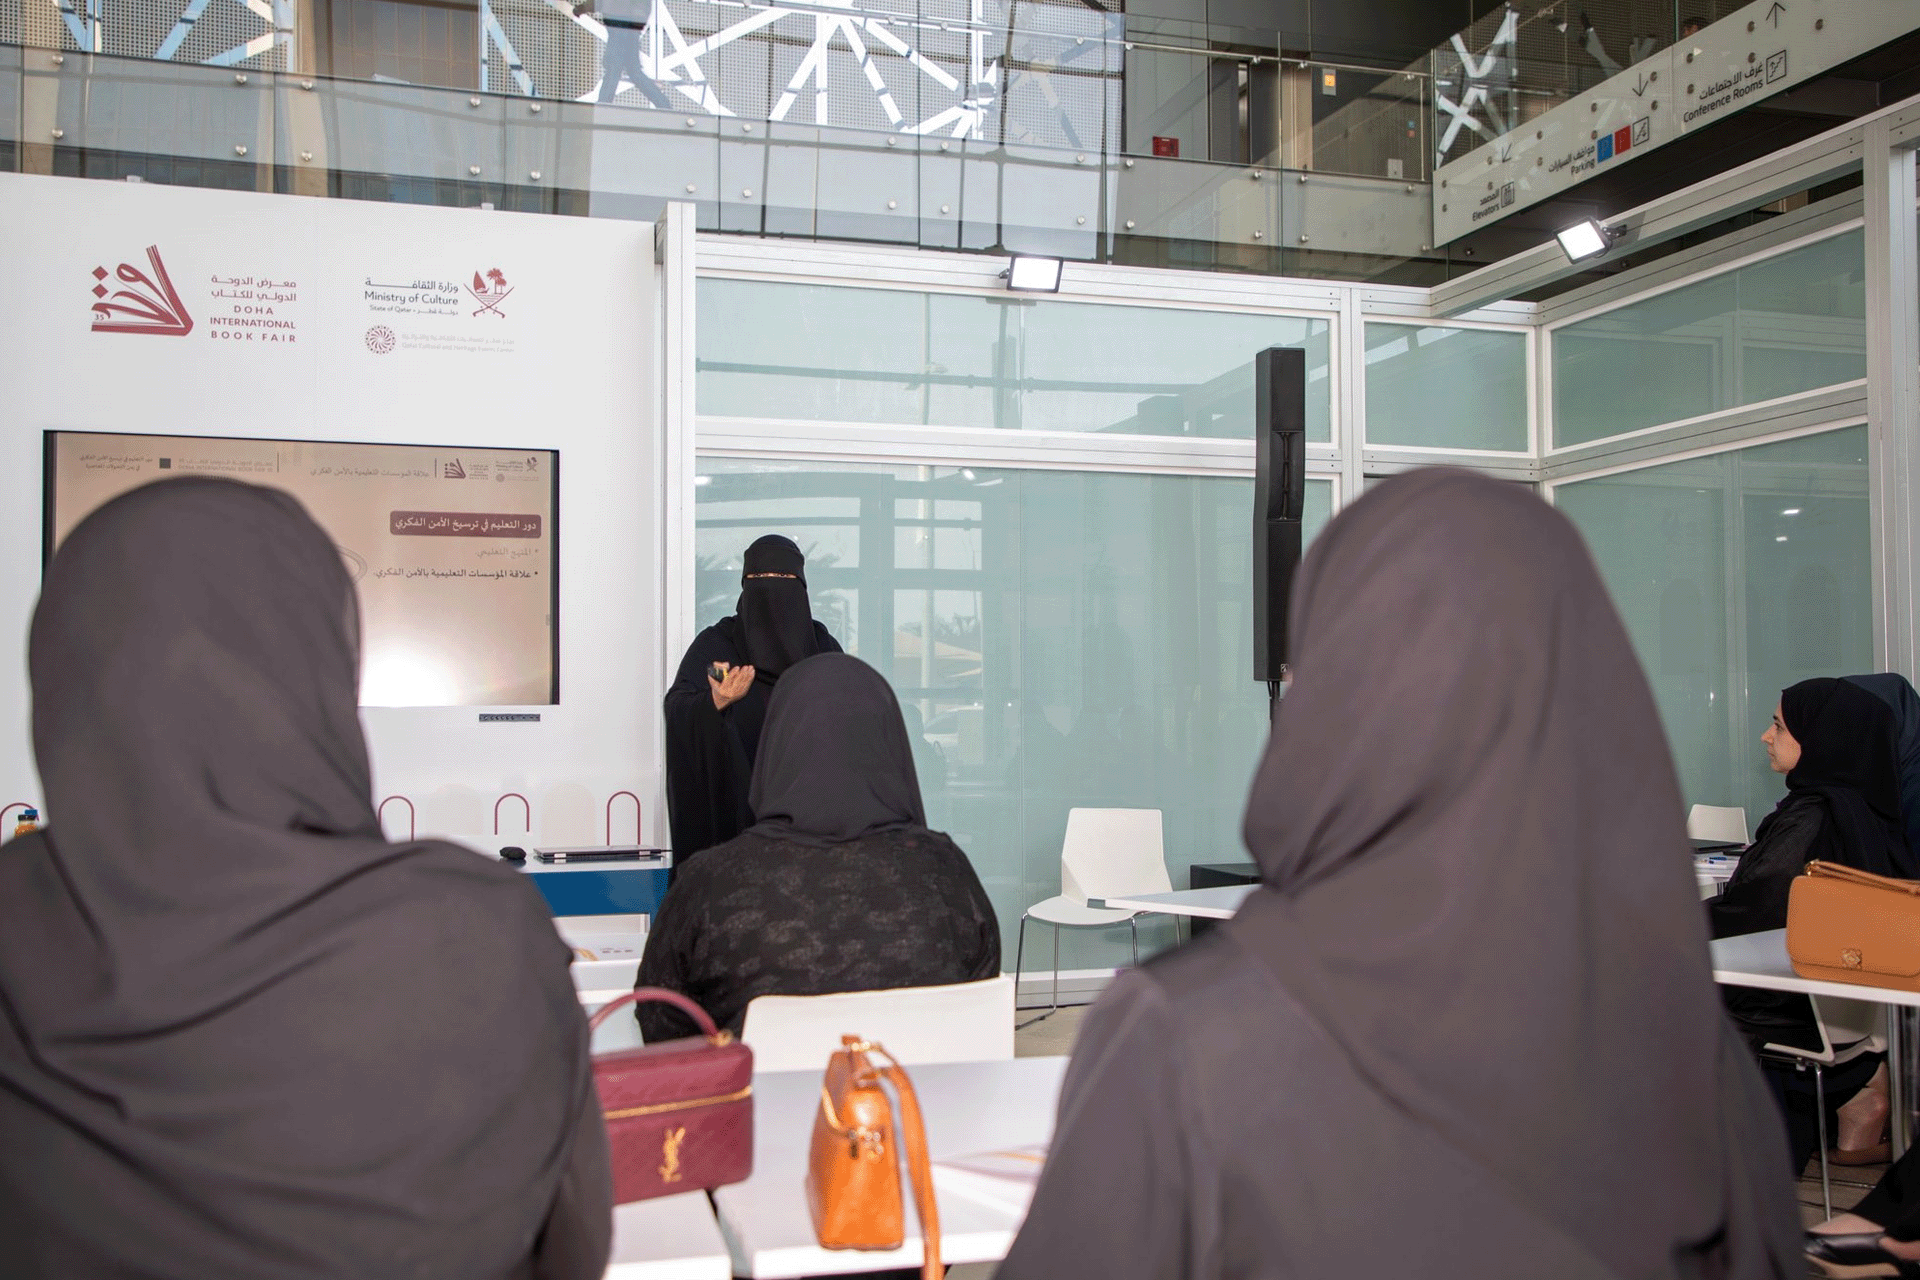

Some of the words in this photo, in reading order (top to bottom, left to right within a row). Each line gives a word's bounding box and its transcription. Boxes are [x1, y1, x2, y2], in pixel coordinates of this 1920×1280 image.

[1744, 62, 1763, 78] غرف
[1699, 72, 1742, 100] الاجتماعات
[1684, 94, 1731, 123] Conference
[1732, 79, 1763, 100] Rooms
[1571, 158, 1595, 176] Parking
[1472, 203, 1500, 222] Elevators
[211, 274, 254, 287] الدوحة
[256, 278, 297, 290] معرض
[365, 277, 436, 290] الثقافة
[211, 288, 253, 299] للكتاب
[438, 281, 459, 294] وزارة
[256, 291, 297, 303] الدولي
[365, 290, 406, 305] Ministry
[408, 294, 419, 303] of
[421, 294, 459, 306] Culture
[233, 305, 274, 315] DOHA
[369, 304, 386, 312] State
[395, 306, 412, 314] Qatar
[209, 317, 296, 329] INTERNATIONAL
[211, 331, 253, 341] BOOK
[262, 333, 296, 343] FAIR
[395, 517, 426, 530] الفكري
[428, 516, 450, 530] الأمن
[452, 519, 479, 532] ترسيخ
[480, 519, 489, 533] في
[491, 520, 520, 532] التعليم
[522, 520, 537, 532] دور
[406, 567, 429, 579] بالأمن
[431, 568, 467, 579] التعليمية
[468, 569, 508, 580] المؤسسات
[509, 569, 532, 579] علاقة
